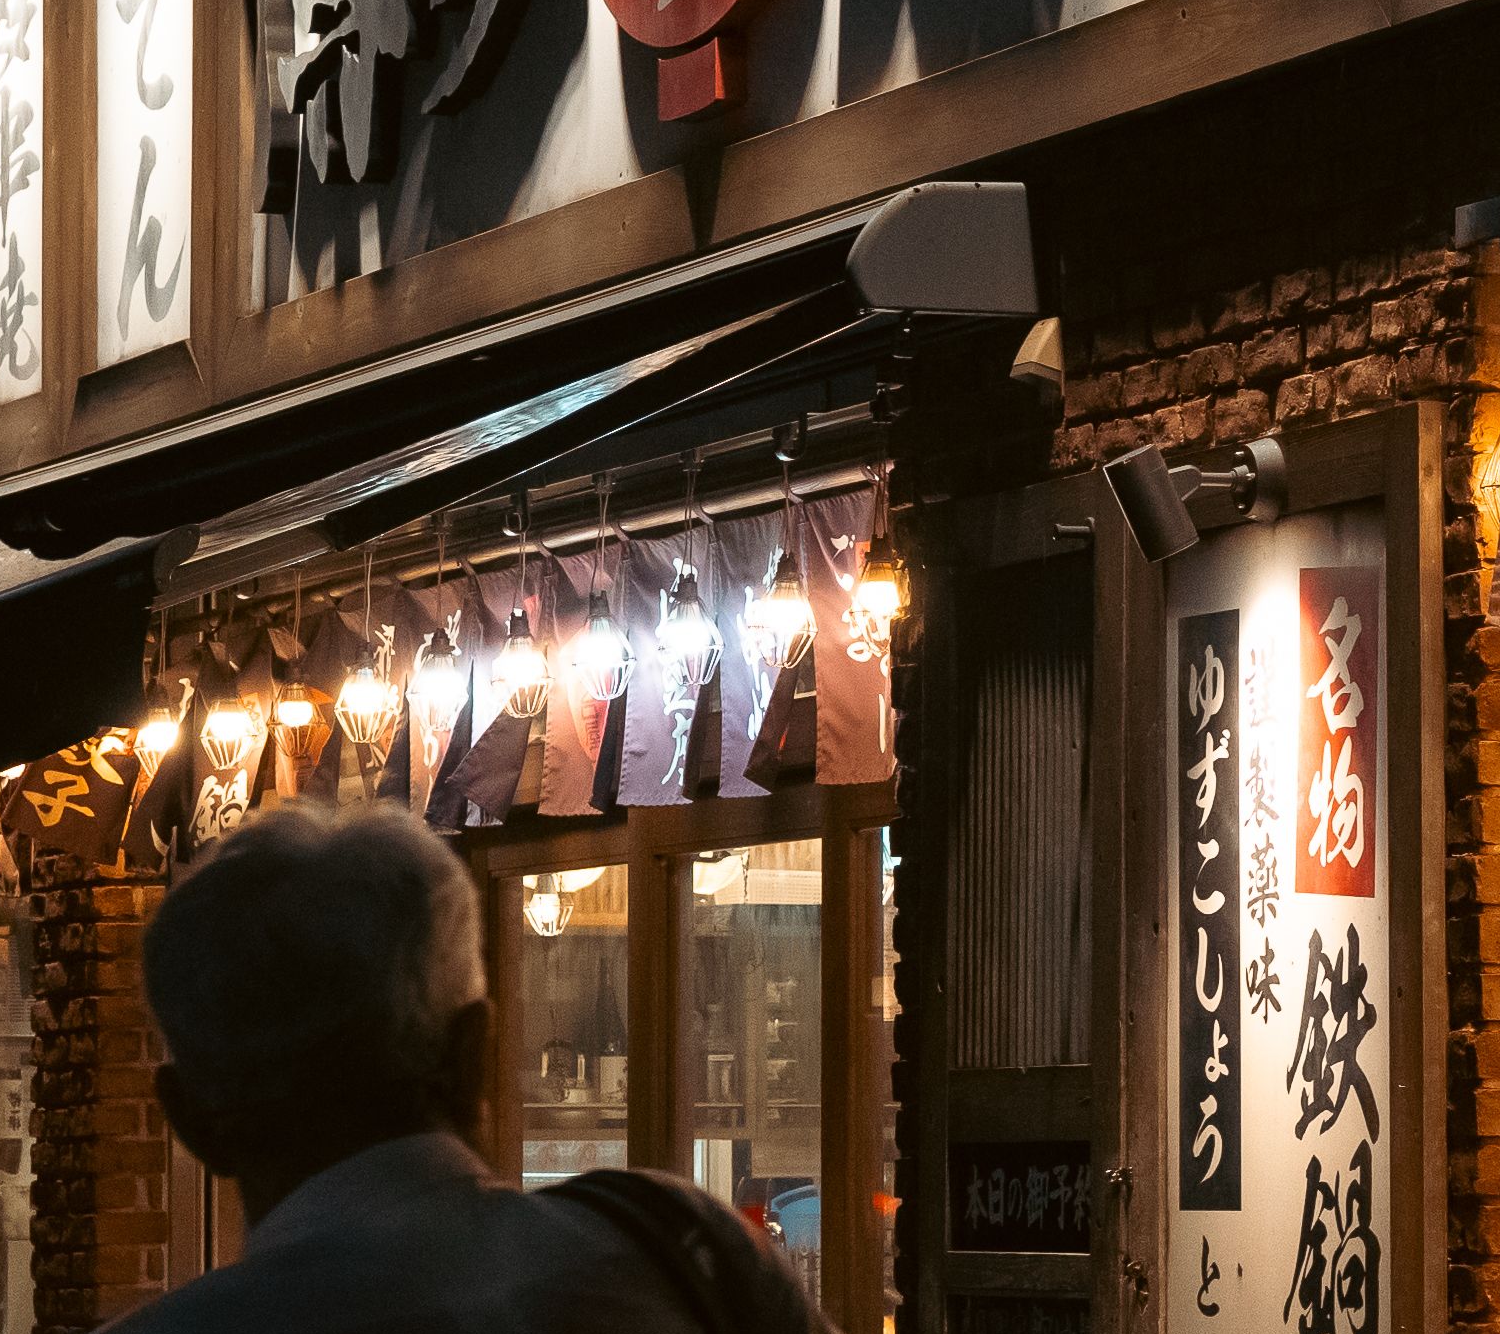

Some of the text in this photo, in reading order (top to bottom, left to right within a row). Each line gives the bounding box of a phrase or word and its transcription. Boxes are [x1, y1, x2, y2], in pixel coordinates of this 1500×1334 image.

[1186, 643, 1231, 1186] ゆずこしょう
[1306, 596, 1366, 871] 名物
